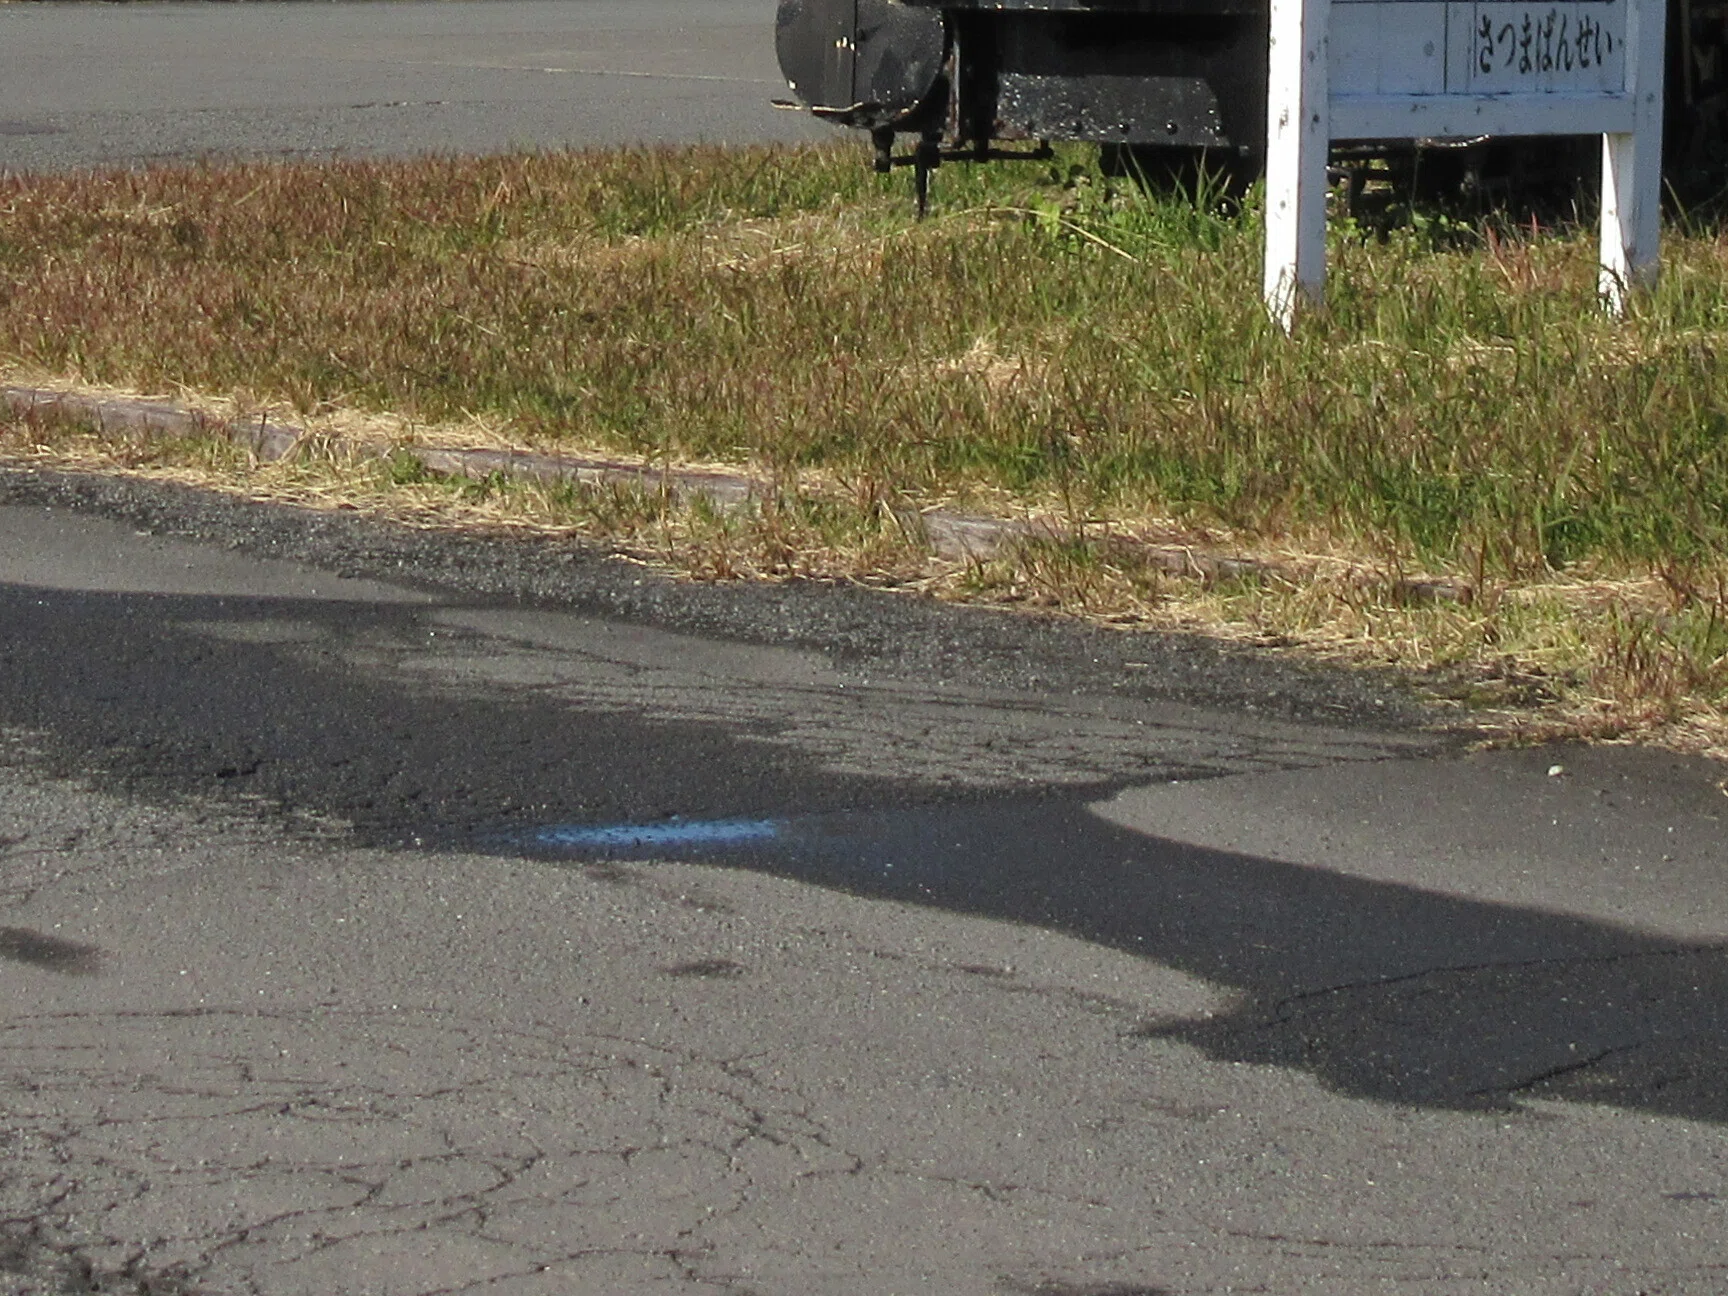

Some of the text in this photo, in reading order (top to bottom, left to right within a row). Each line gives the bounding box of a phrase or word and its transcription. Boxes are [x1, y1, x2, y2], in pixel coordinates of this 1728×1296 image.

[1478, 8, 1612, 75] さつまばんせい
